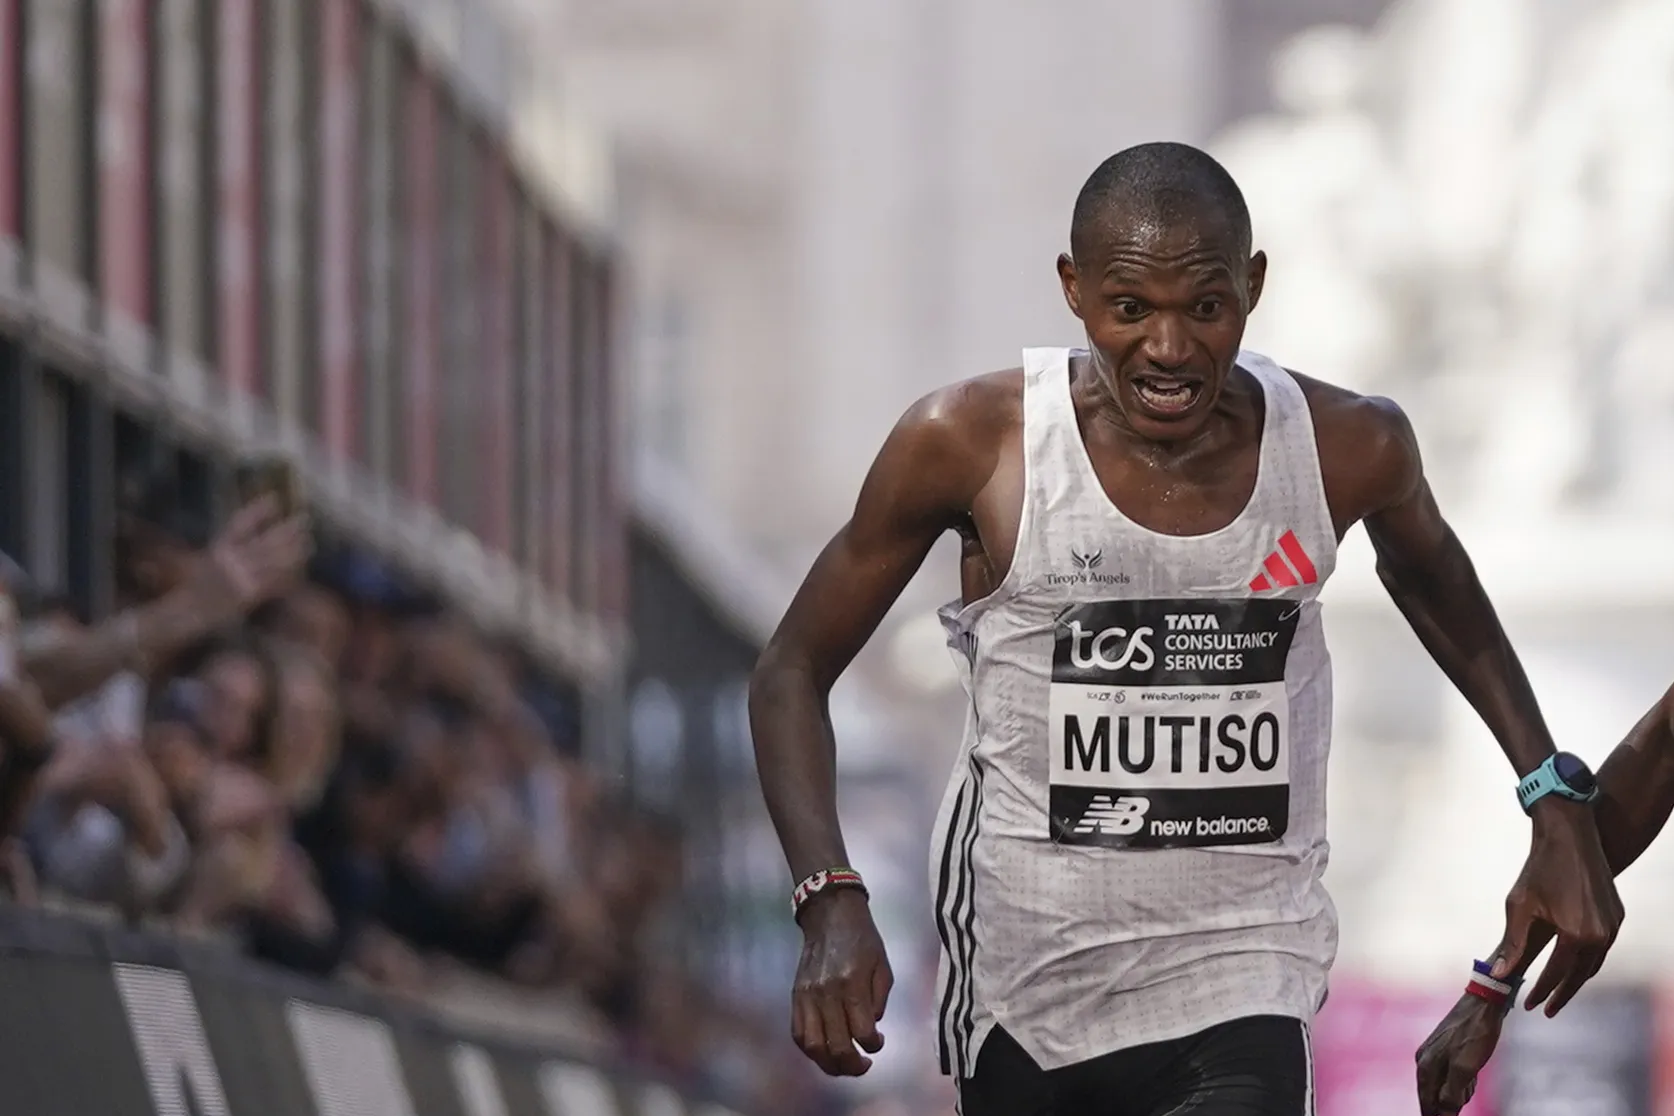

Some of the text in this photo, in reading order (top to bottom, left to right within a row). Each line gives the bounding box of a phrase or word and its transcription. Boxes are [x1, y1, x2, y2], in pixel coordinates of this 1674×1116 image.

[1044, 572, 1131, 586] Tirop's Angels
[1164, 614, 1220, 630] TATA
[1070, 620, 1155, 671] tcs
[1164, 632, 1278, 651] CONSULTANCY
[1164, 654, 1244, 671] SERVICES
[1141, 691, 1221, 702] #WeRunTogether
[1063, 712, 1280, 774] MUTISO
[1151, 820, 1193, 836] new
[1196, 815, 1268, 836] balance
